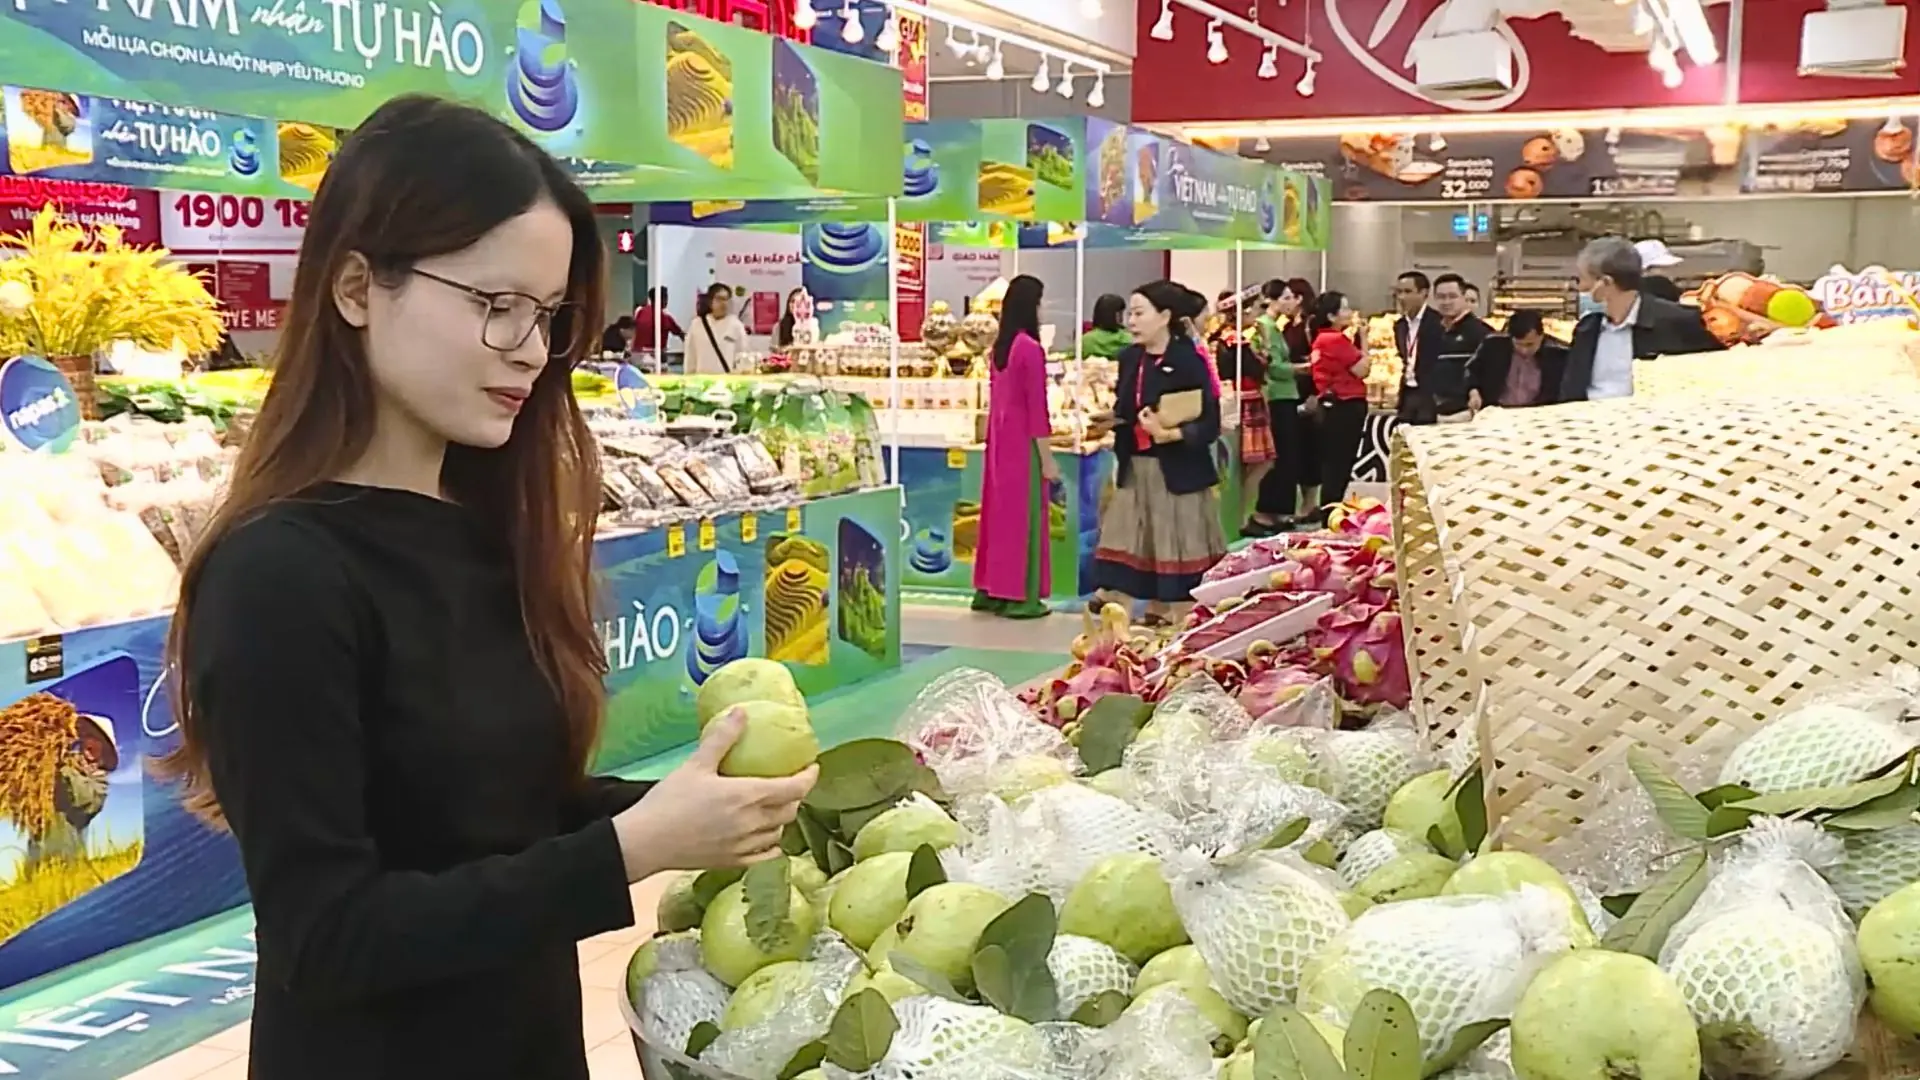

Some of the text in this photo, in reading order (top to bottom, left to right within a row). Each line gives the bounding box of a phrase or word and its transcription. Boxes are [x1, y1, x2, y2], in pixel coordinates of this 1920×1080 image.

[82, 24, 117, 48] MỖI
[118, 35, 150, 56] LỰA
[150, 41, 199, 64] CHỌN
[199, 46, 219, 66] LÀ
[218, 52, 251, 72] MỘT
[252, 57, 286, 77] NHỊP
[286, 60, 313, 80] YÊU
[250, 4, 324, 36] nhận
[322, 0, 387, 70] TỰ
[393, 1, 484, 76] HÀO
[134, 121, 169, 157] TỰ
[171, 122, 221, 158] HÀO
[174, 193, 264, 228] 1900
[1195, 180, 1217, 207] NAM
[255, 309, 277, 327] ME
[604, 600, 680, 673] HÀO
